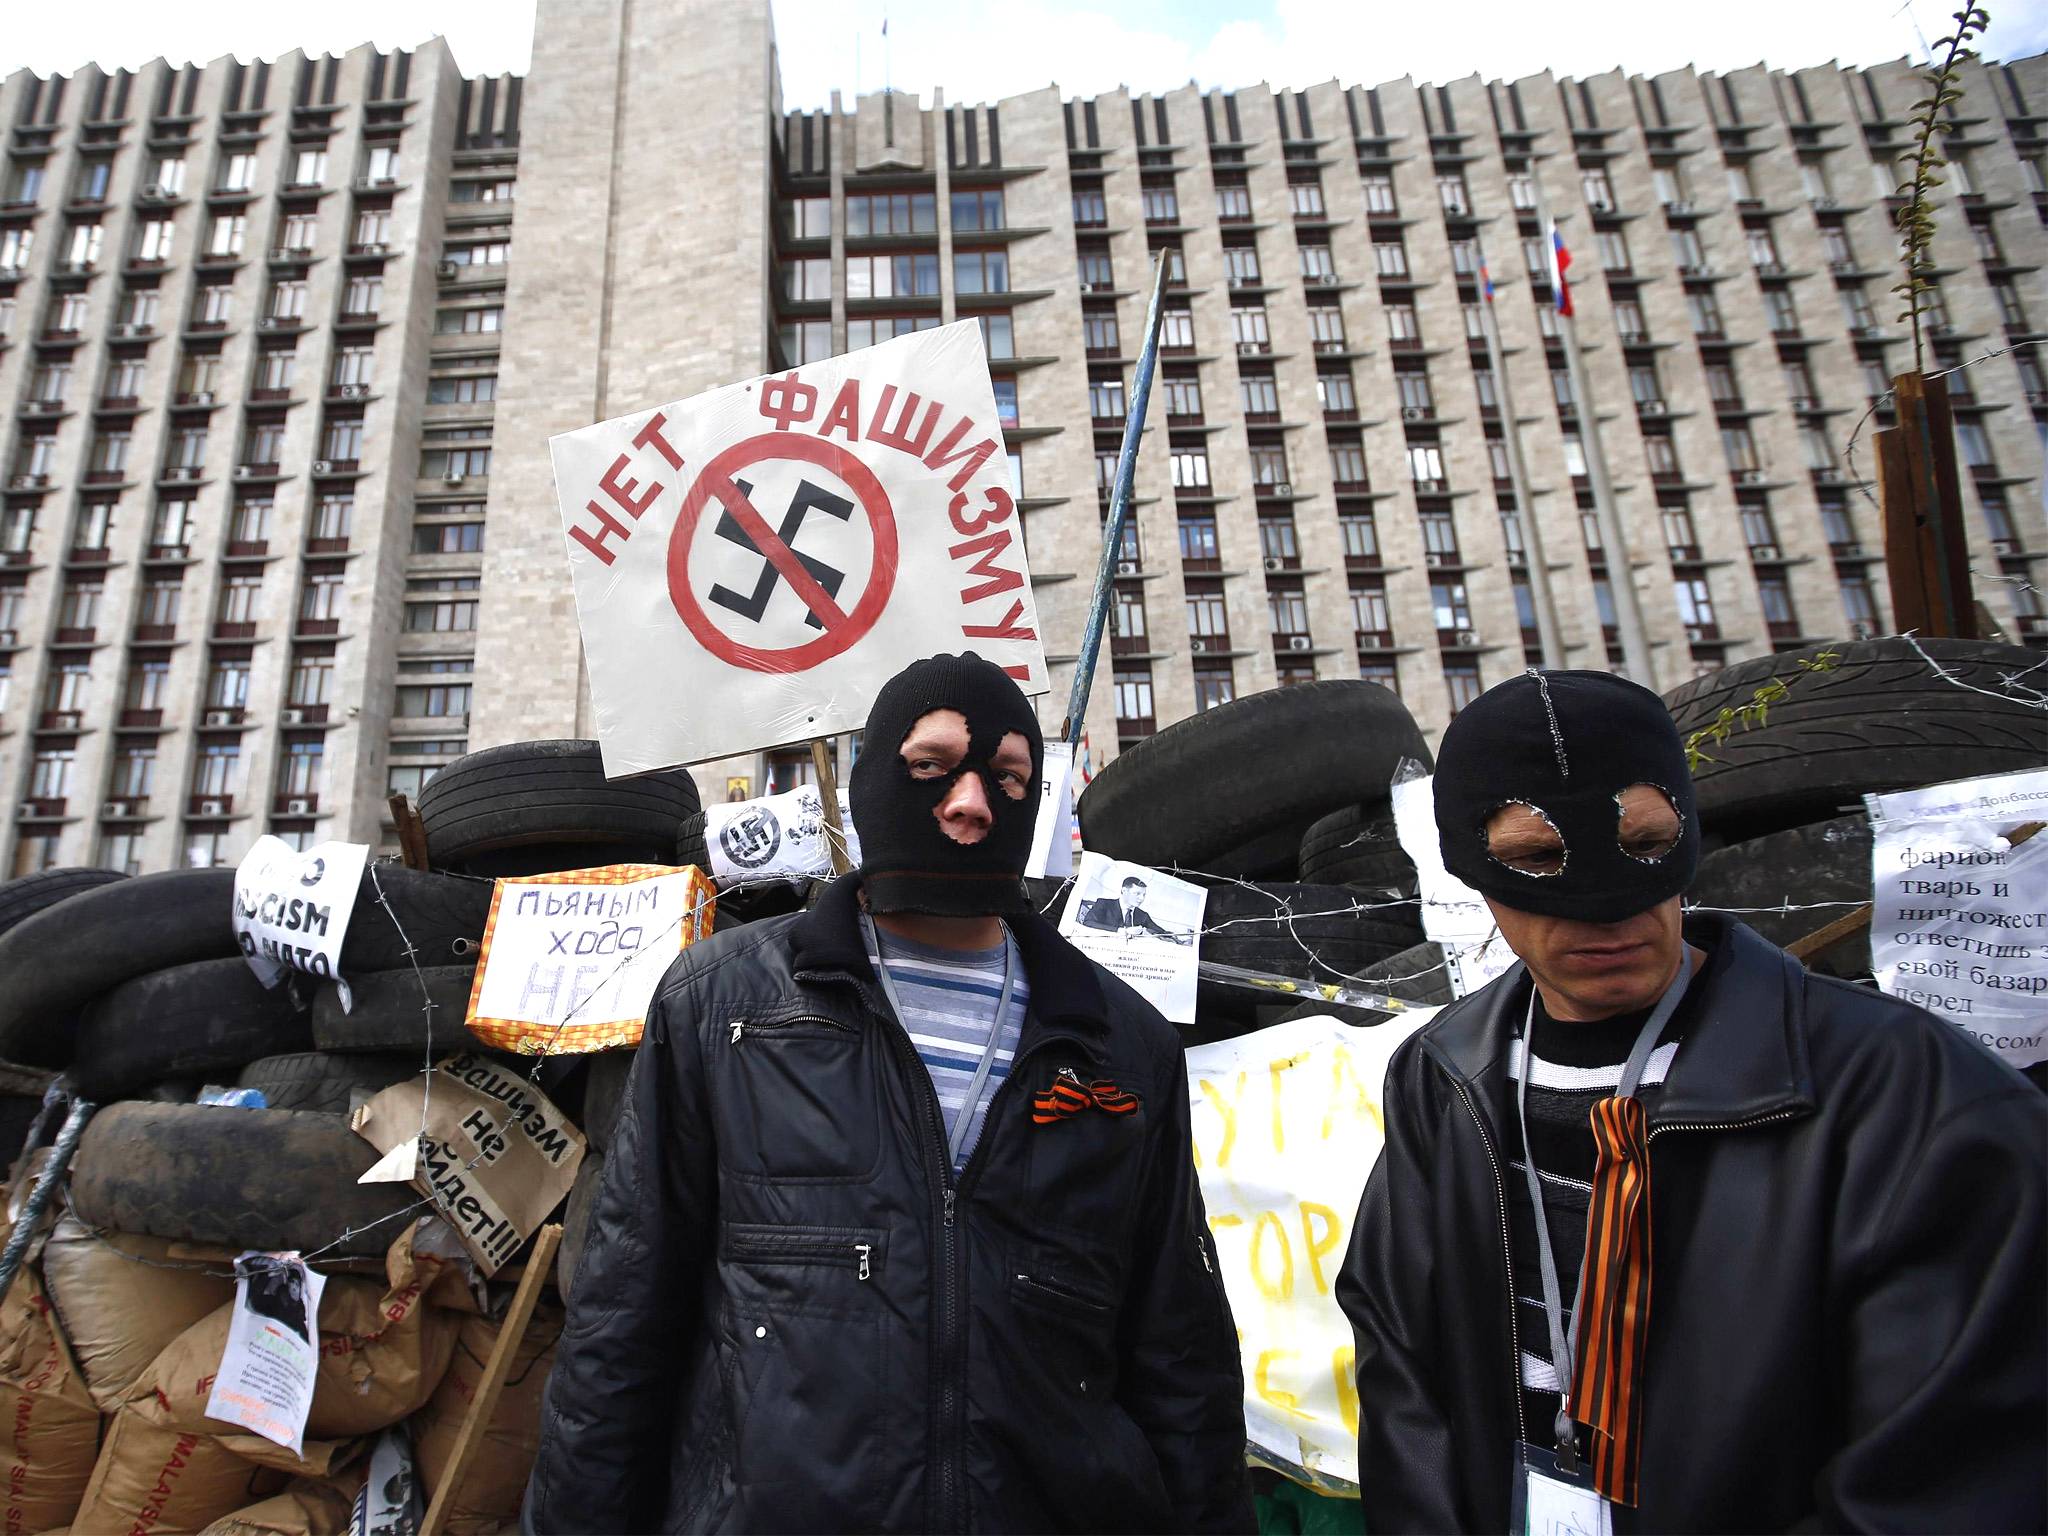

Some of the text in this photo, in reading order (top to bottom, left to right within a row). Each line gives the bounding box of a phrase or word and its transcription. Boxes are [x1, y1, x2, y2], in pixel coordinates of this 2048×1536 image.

[568, 413, 685, 567] НЕТ
[516, 885, 659, 918] ПЬЯНЫМ
[1899, 879, 2009, 899] тварь и
[1897, 907, 2048, 929] ничтожест
[1894, 931, 2031, 960] ответишь
[1897, 959, 2048, 997] свой базар
[1896, 986, 1973, 1014] перед
[444, 1053, 568, 1164] Фашизм
[463, 1110, 505, 1161] Не
[418, 1136, 521, 1268] ойдет!!!
